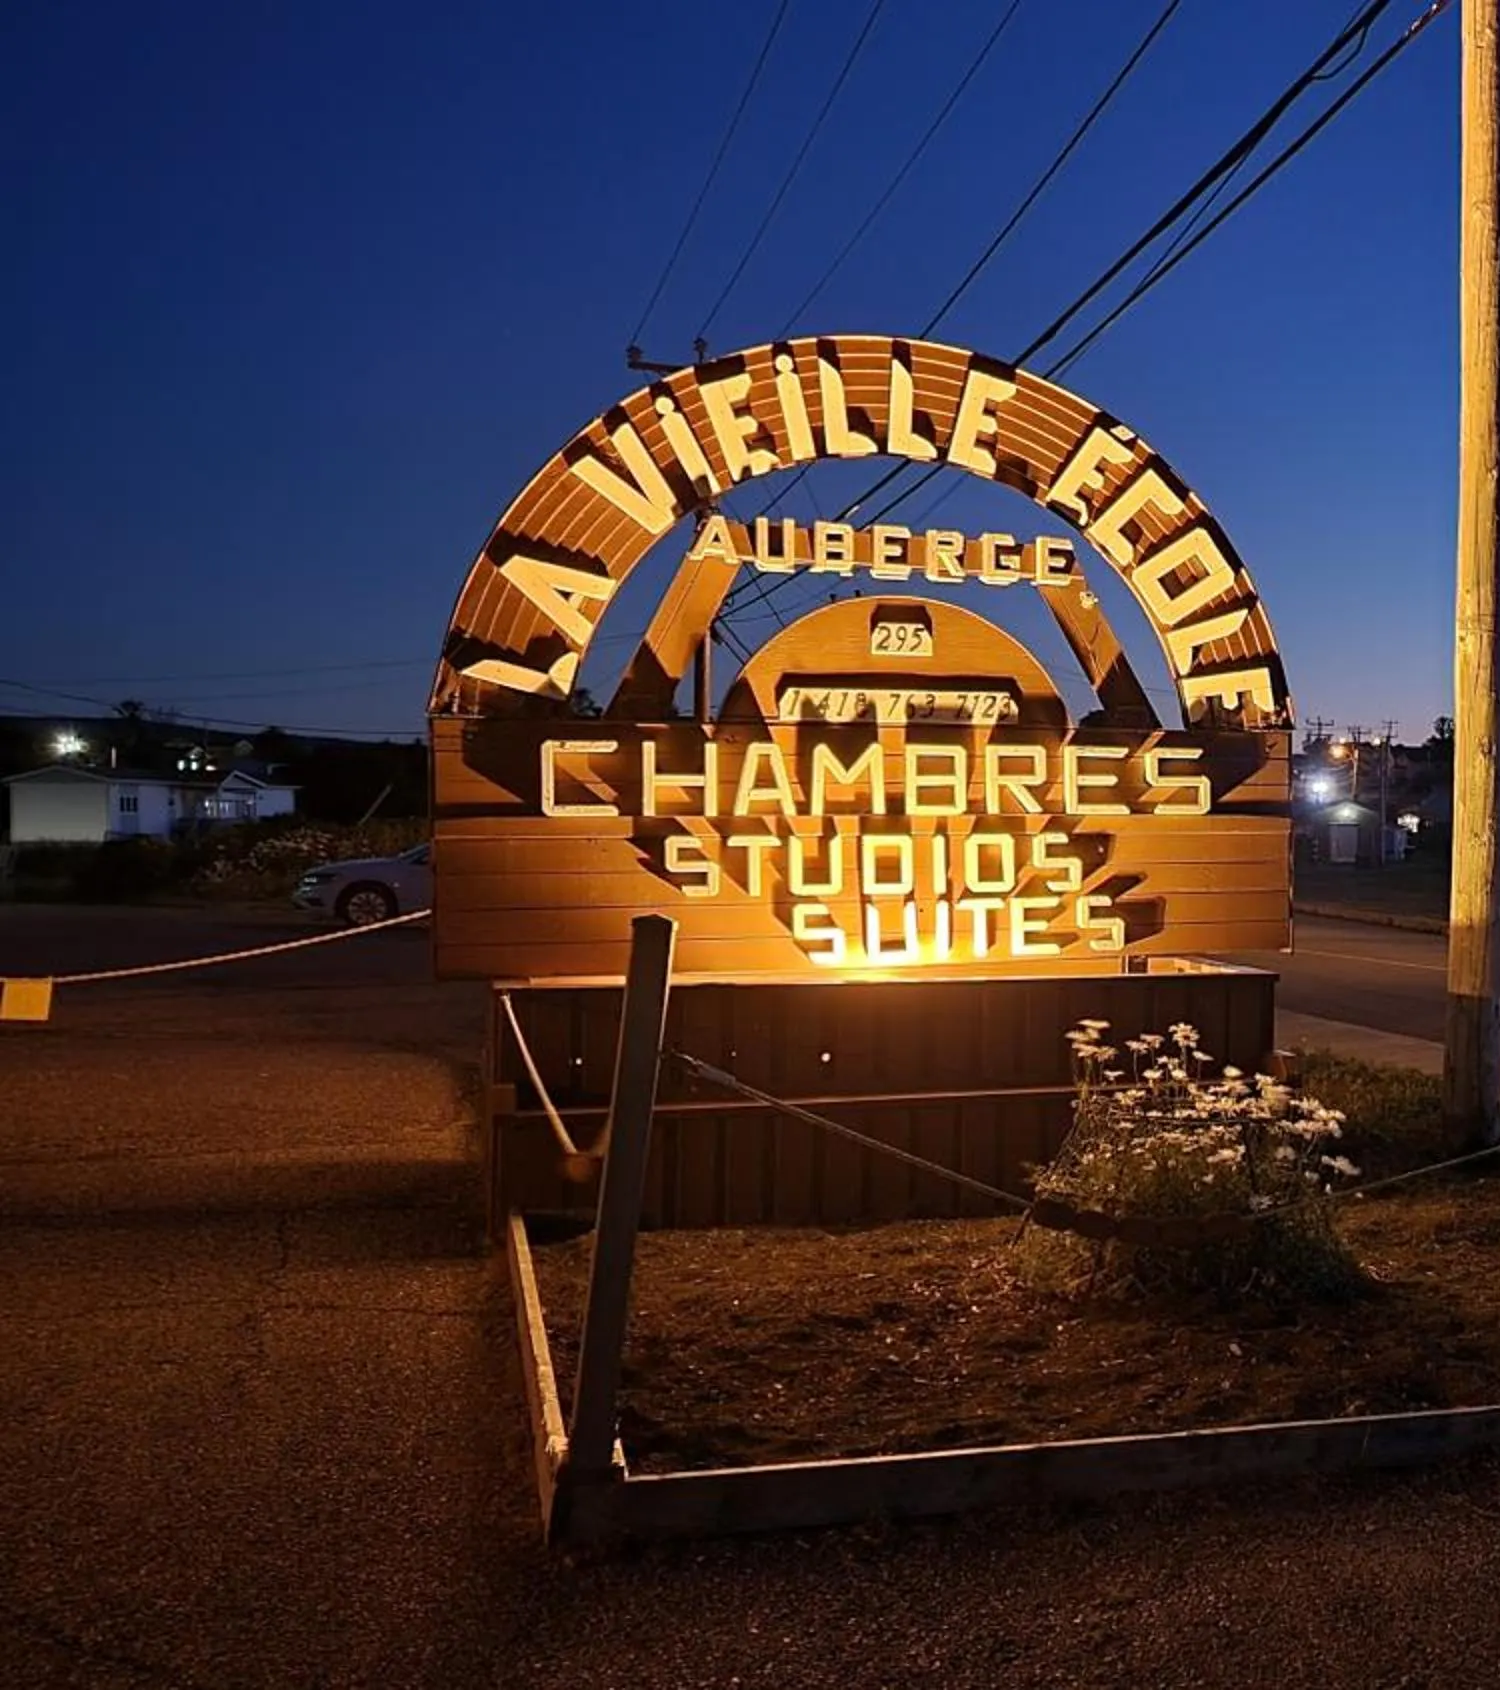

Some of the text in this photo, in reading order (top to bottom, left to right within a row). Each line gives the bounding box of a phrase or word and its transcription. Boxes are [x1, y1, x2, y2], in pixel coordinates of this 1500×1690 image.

[460, 554, 617, 697] LA
[1045, 424, 1275, 723] ÉCOLE
[686, 514, 1075, 588] AUBERGE
[874, 625, 925, 651] 295
[787, 689, 1012, 720] 1 418 763 7123
[541, 740, 1211, 817] CHAMBRES
[664, 831, 1083, 898] STUDIOS
[792, 895, 1126, 967] SUITES
